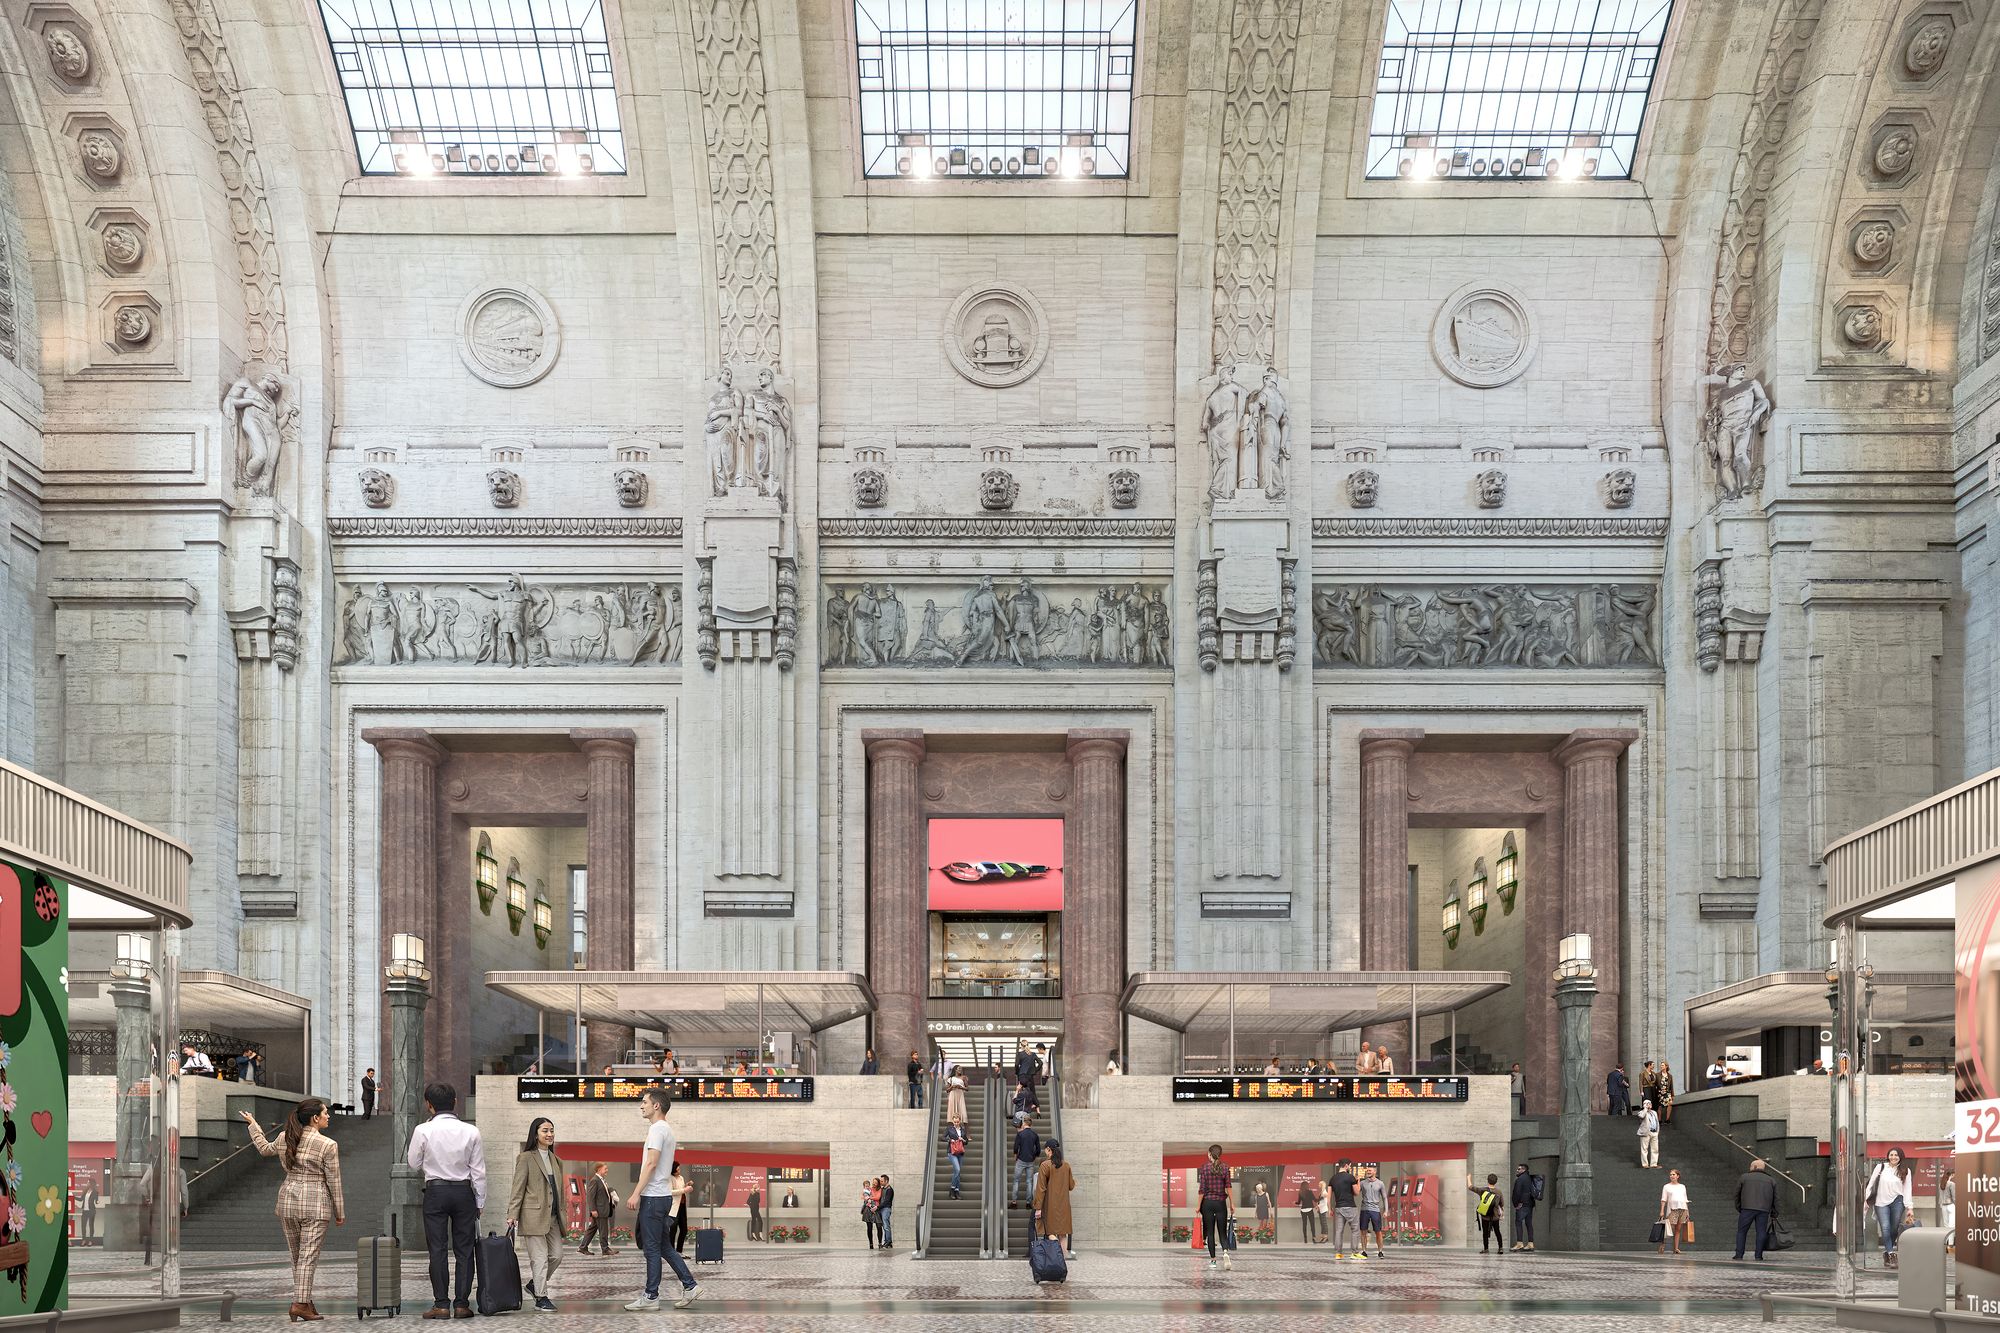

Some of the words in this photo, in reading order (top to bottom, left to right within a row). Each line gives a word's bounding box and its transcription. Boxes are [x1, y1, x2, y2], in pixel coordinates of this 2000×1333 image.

[945, 1023, 965, 1031] Treni
[965, 1023, 985, 1031] Trains
[1967, 1107, 2000, 1145] 32
[1967, 1173, 2000, 1193] Inte
[1967, 1294, 1979, 1312] Ti
